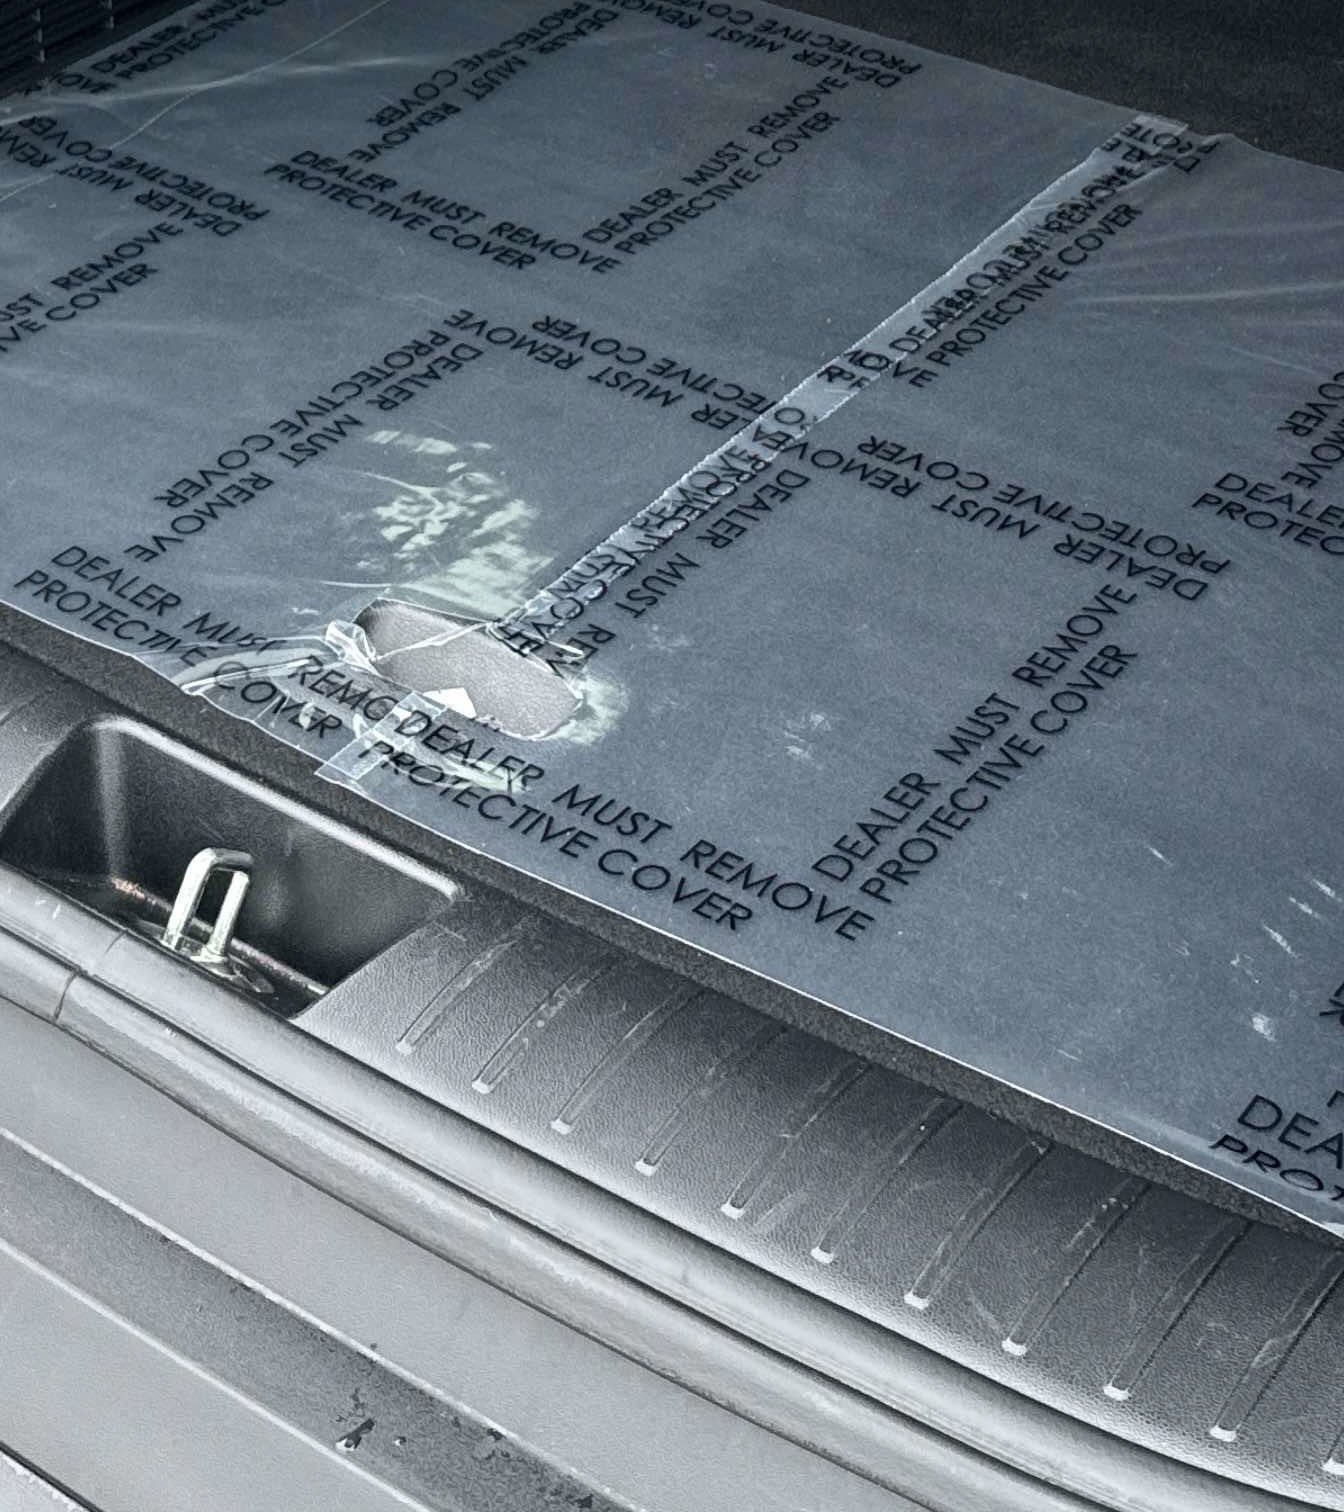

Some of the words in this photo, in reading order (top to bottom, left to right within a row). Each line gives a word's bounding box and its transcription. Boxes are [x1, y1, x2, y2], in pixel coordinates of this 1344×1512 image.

[453, 1, 593, 72] PROTECTIVE
[529, 8, 619, 55] DEALER
[706, 25, 786, 53] MUST
[758, 18, 923, 75] PROTECTIVE
[365, 69, 458, 127] COVER
[463, 56, 529, 101] MUST
[792, 50, 902, 88] DEALER
[18, 115, 113, 163] COVER
[347, 102, 462, 162] REMOVE
[582, 187, 683, 245] DEALER
[682, 141, 751, 187] MUST
[746, 75, 850, 138] REMOVE
[56, 163, 134, 192] MUST
[109, 155, 270, 222] PROTECTIVE
[290, 150, 398, 193] DEALER
[403, 190, 487, 225] MUST
[489, 221, 622, 273] REMOVE
[614, 168, 762, 255] PROTECTIVE
[754, 111, 842, 169] COVER
[135, 188, 243, 237] DEALER
[264, 163, 433, 231] PROTECTIVE
[429, 224, 537, 271] COVER
[50, 221, 184, 291] REMOVE
[926, 264, 1069, 367] PROTECTIVE
[1057, 203, 1144, 266] COVER
[45, 263, 159, 321] COVER
[444, 309, 583, 370] REMOVE
[532, 314, 647, 365] COVER
[270, 329, 452, 437] PROTECTIVE
[366, 343, 484, 411] DEALER
[588, 367, 684, 408] MUST
[153, 434, 274, 509] COVER
[278, 413, 365, 468] MUST
[762, 429, 922, 499] REMOVE
[857, 434, 990, 490] COVER
[123, 472, 274, 564] REMOVE
[695, 469, 811, 550] DEALER
[932, 493, 1041, 540] MUST
[993, 483, 1232, 576] PROTECTIVE
[50, 544, 182, 617] DEALER
[183, 611, 287, 655] MUST
[614, 551, 701, 619] MUST
[1053, 533, 1210, 602] DEALER
[13, 570, 223, 668] PROTECTIVE
[213, 660, 344, 738] COVER
[811, 771, 942, 883] DEALER
[933, 692, 1021, 765] MUST
[1012, 584, 1139, 687] REMOVE
[859, 733, 1046, 905] PROTECTIVE
[1031, 643, 1139, 734] COVER
[358, 740, 598, 860] PROTECTIVE
[598, 848, 754, 931] COVER
[395, 707, 546, 787] DEALER
[554, 784, 673, 845] MUST
[680, 839, 877, 942] REMOVE
